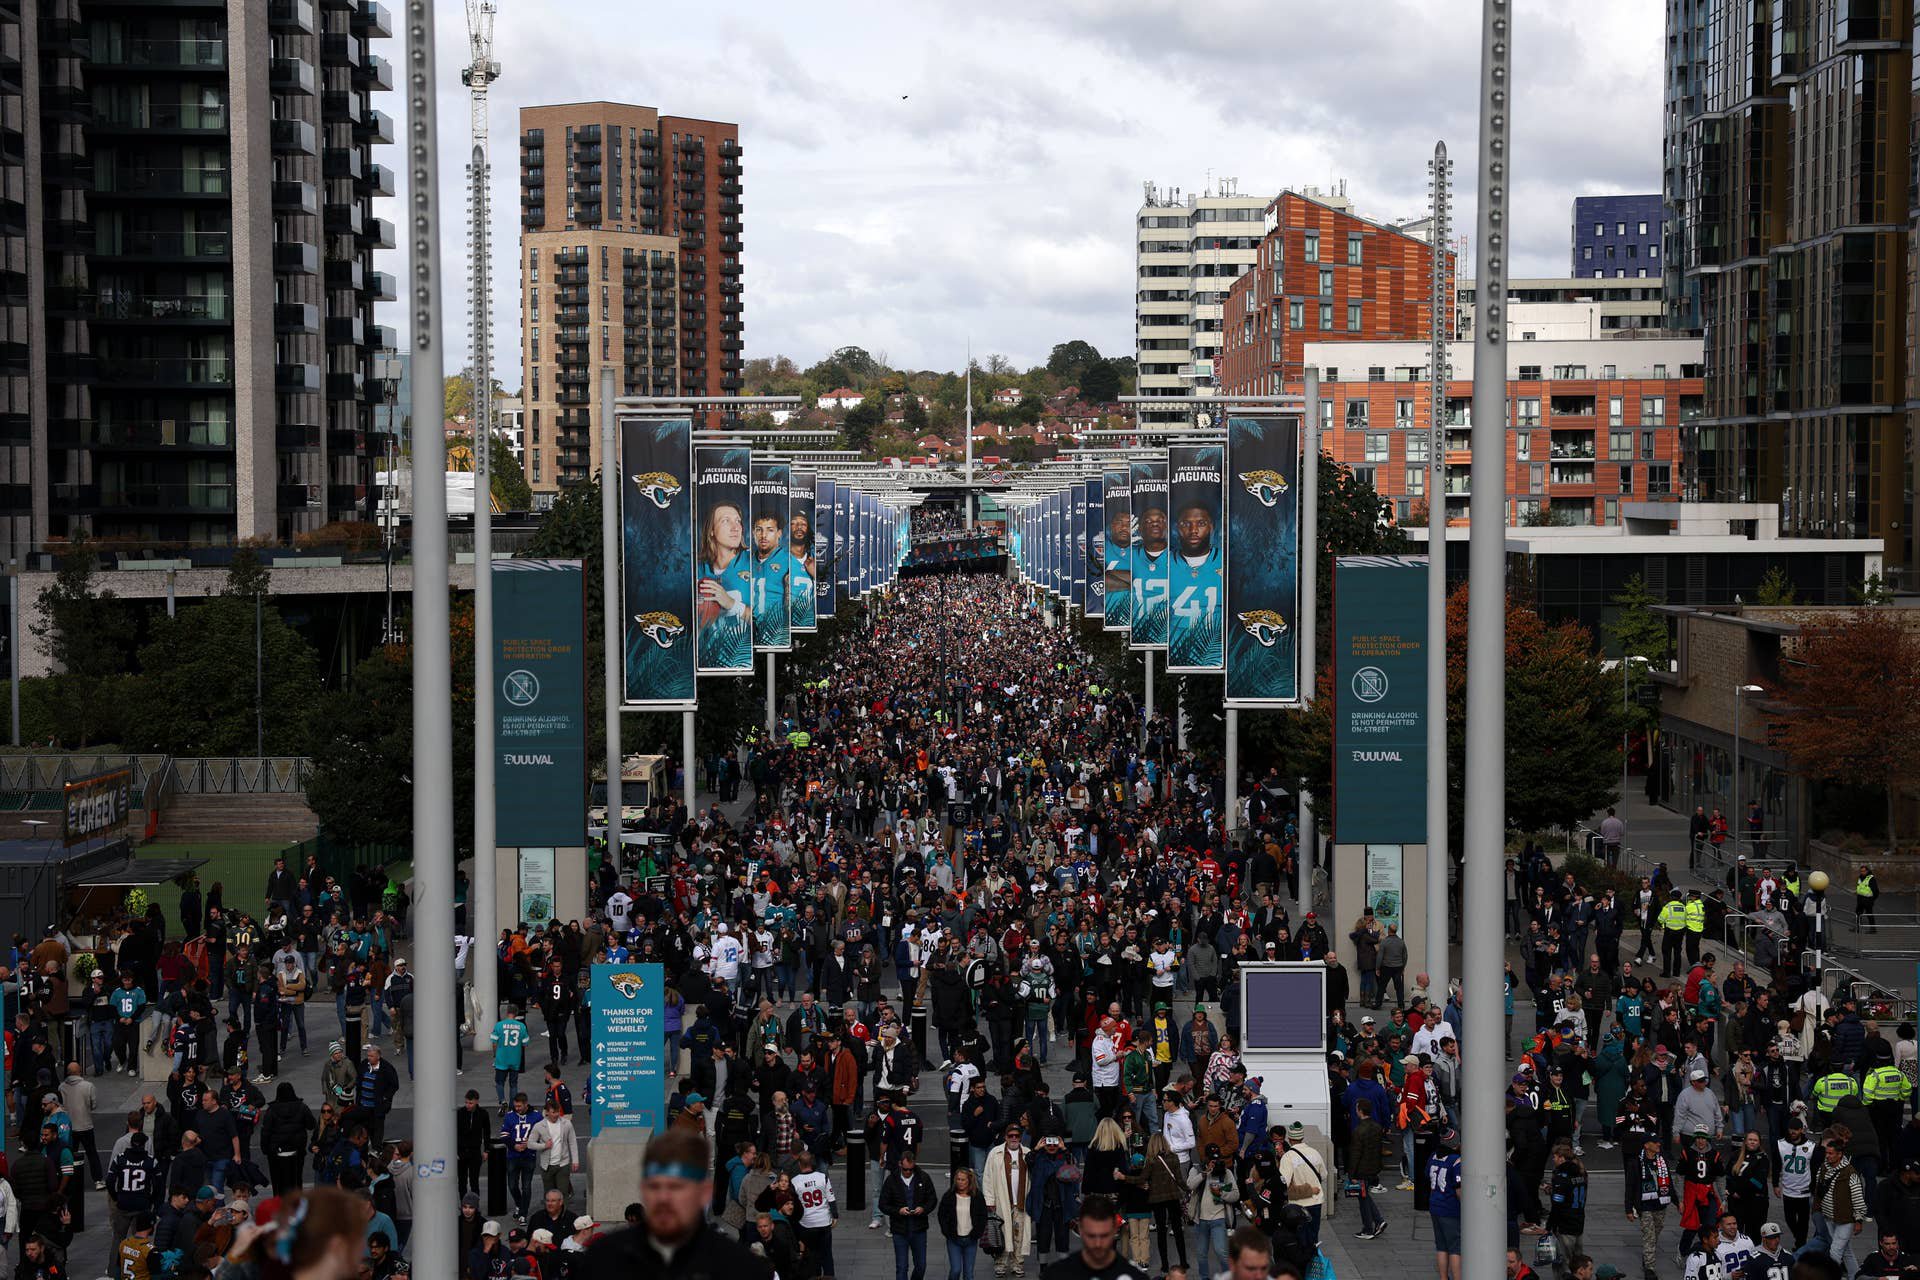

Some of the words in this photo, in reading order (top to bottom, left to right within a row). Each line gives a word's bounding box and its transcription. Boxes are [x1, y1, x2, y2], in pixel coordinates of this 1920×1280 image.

[699, 473, 747, 485] JAGUARS
[1171, 472, 1221, 483] JAGUARS
[790, 491, 815, 499] GUARS
[1105, 490, 1130, 499] JAGUA
[1133, 483, 1168, 493] JAGUAR
[1171, 586, 1218, 620] 41
[79, 789, 117, 834] GREEK
[612, 904, 623, 917] 10
[923, 939, 936, 952] 86
[553, 985, 561, 1000] 9
[121, 998, 133, 1013] 16
[602, 1008, 635, 1016] THANKS
[636, 1008, 653, 1016] FOR
[1628, 1005, 1641, 1017] 30
[607, 1025, 648, 1033] WEMBLEY
[503, 1030, 519, 1047] 13
[188, 1042, 197, 1059] 10
[514, 1123, 532, 1143] 17
[903, 1127, 912, 1145] 4
[1697, 1160, 1706, 1179] 9
[1783, 1154, 1806, 1175] 20
[121, 1169, 147, 1192] 12
[802, 1189, 823, 1208] 99
